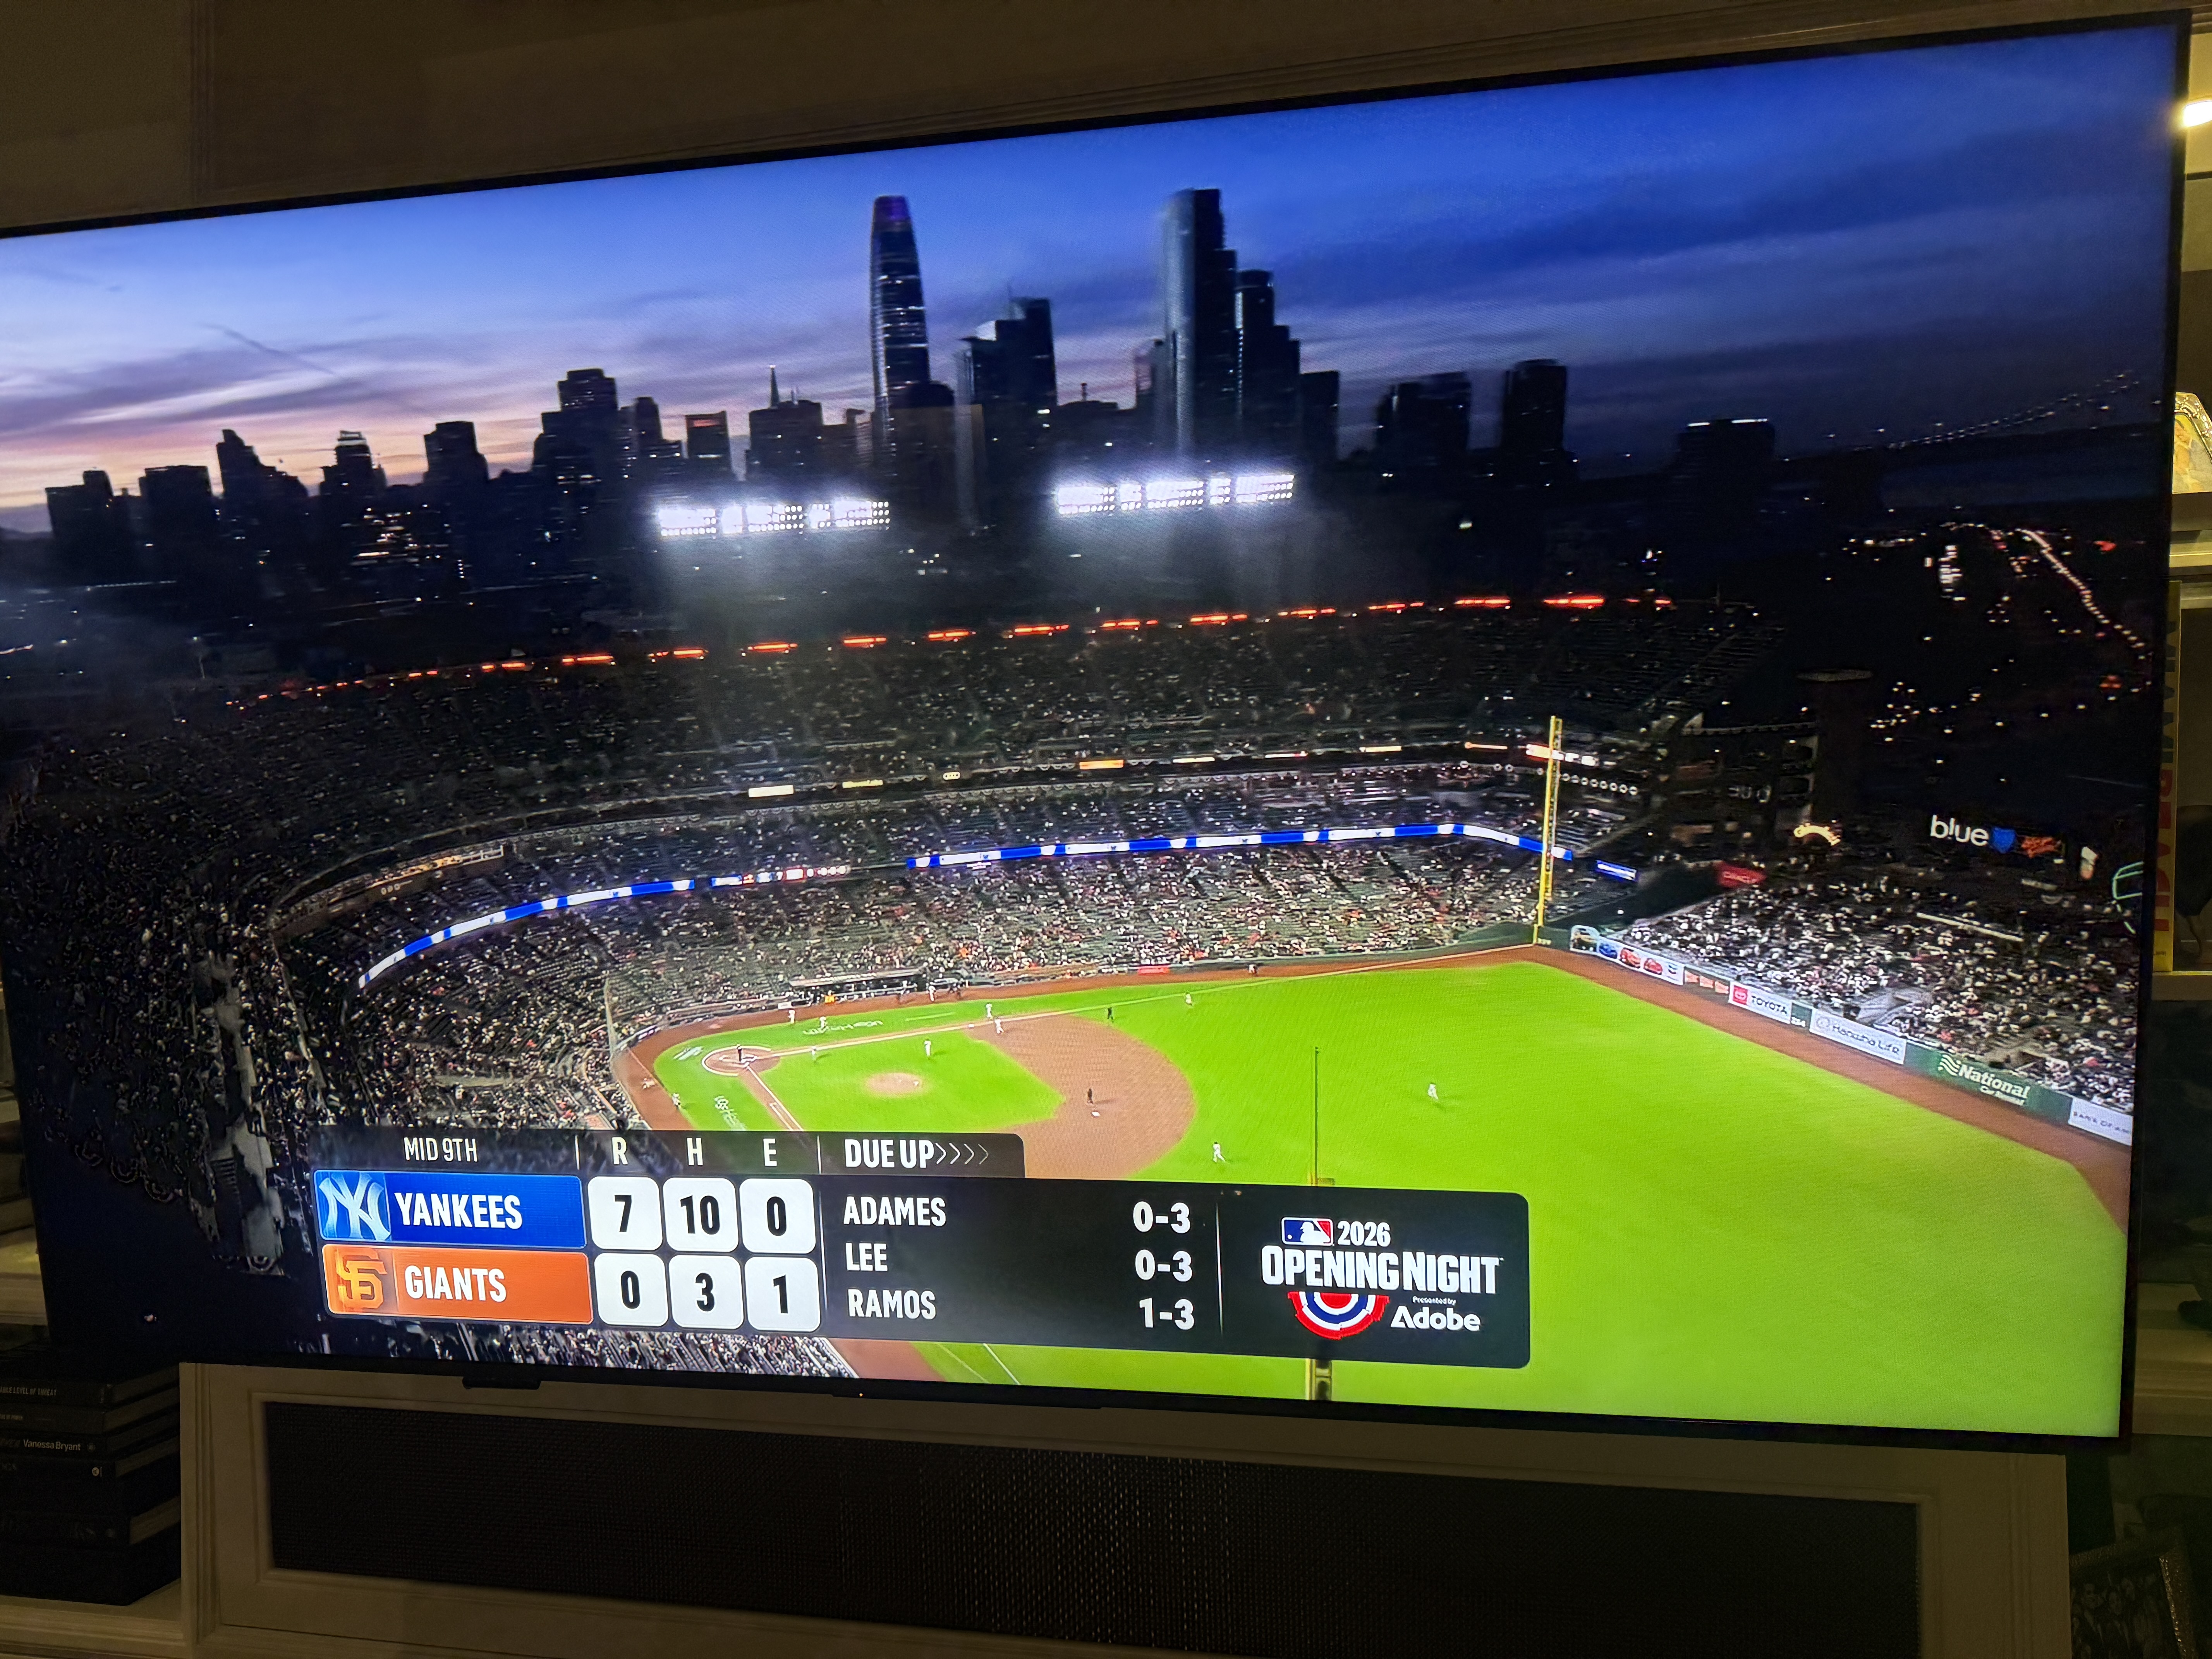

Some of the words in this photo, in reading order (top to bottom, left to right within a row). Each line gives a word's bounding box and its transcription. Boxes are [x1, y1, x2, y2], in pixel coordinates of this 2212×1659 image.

[1930, 815, 1989, 847] blue
[1752, 996, 1788, 1015] TOYOTA
[1958, 1064, 2031, 1099] National
[404, 1137, 438, 1160] MID
[443, 1138, 477, 1162] 9TH
[612, 1137, 628, 1164] R
[687, 1138, 703, 1165] H
[763, 1139, 777, 1166] E
[845, 1139, 895, 1168] DUE
[900, 1140, 934, 1168] UP
[394, 1193, 522, 1229] YANKEES
[615, 1195, 632, 1232] 7
[680, 1195, 720, 1235] 10
[767, 1197, 787, 1236] 0
[844, 1197, 946, 1226] ADAMES
[1133, 1201, 1190, 1233] 0-3
[1338, 1221, 1391, 1247] 2026
[846, 1243, 888, 1271] LEE
[1135, 1250, 1192, 1281] 0-3
[1261, 1246, 1399, 1290] OPENING
[1403, 1252, 1499, 1293] NIGHT
[405, 1266, 506, 1302] GIANTS
[621, 1271, 640, 1309] 0
[696, 1273, 714, 1311] 3
[773, 1275, 788, 1313] 1
[848, 1289, 936, 1319] RAMOS
[1140, 1298, 1194, 1329] 1-3
[1413, 1296, 1446, 1304] Presented
[1391, 1306, 1480, 1331] Adobe
[13, 1387, 28, 1395] LEVEL
[38, 1388, 57, 1396] THREAT
[23, 1439, 55, 1449] Vanessa
[55, 1441, 81, 1452] Bryant
